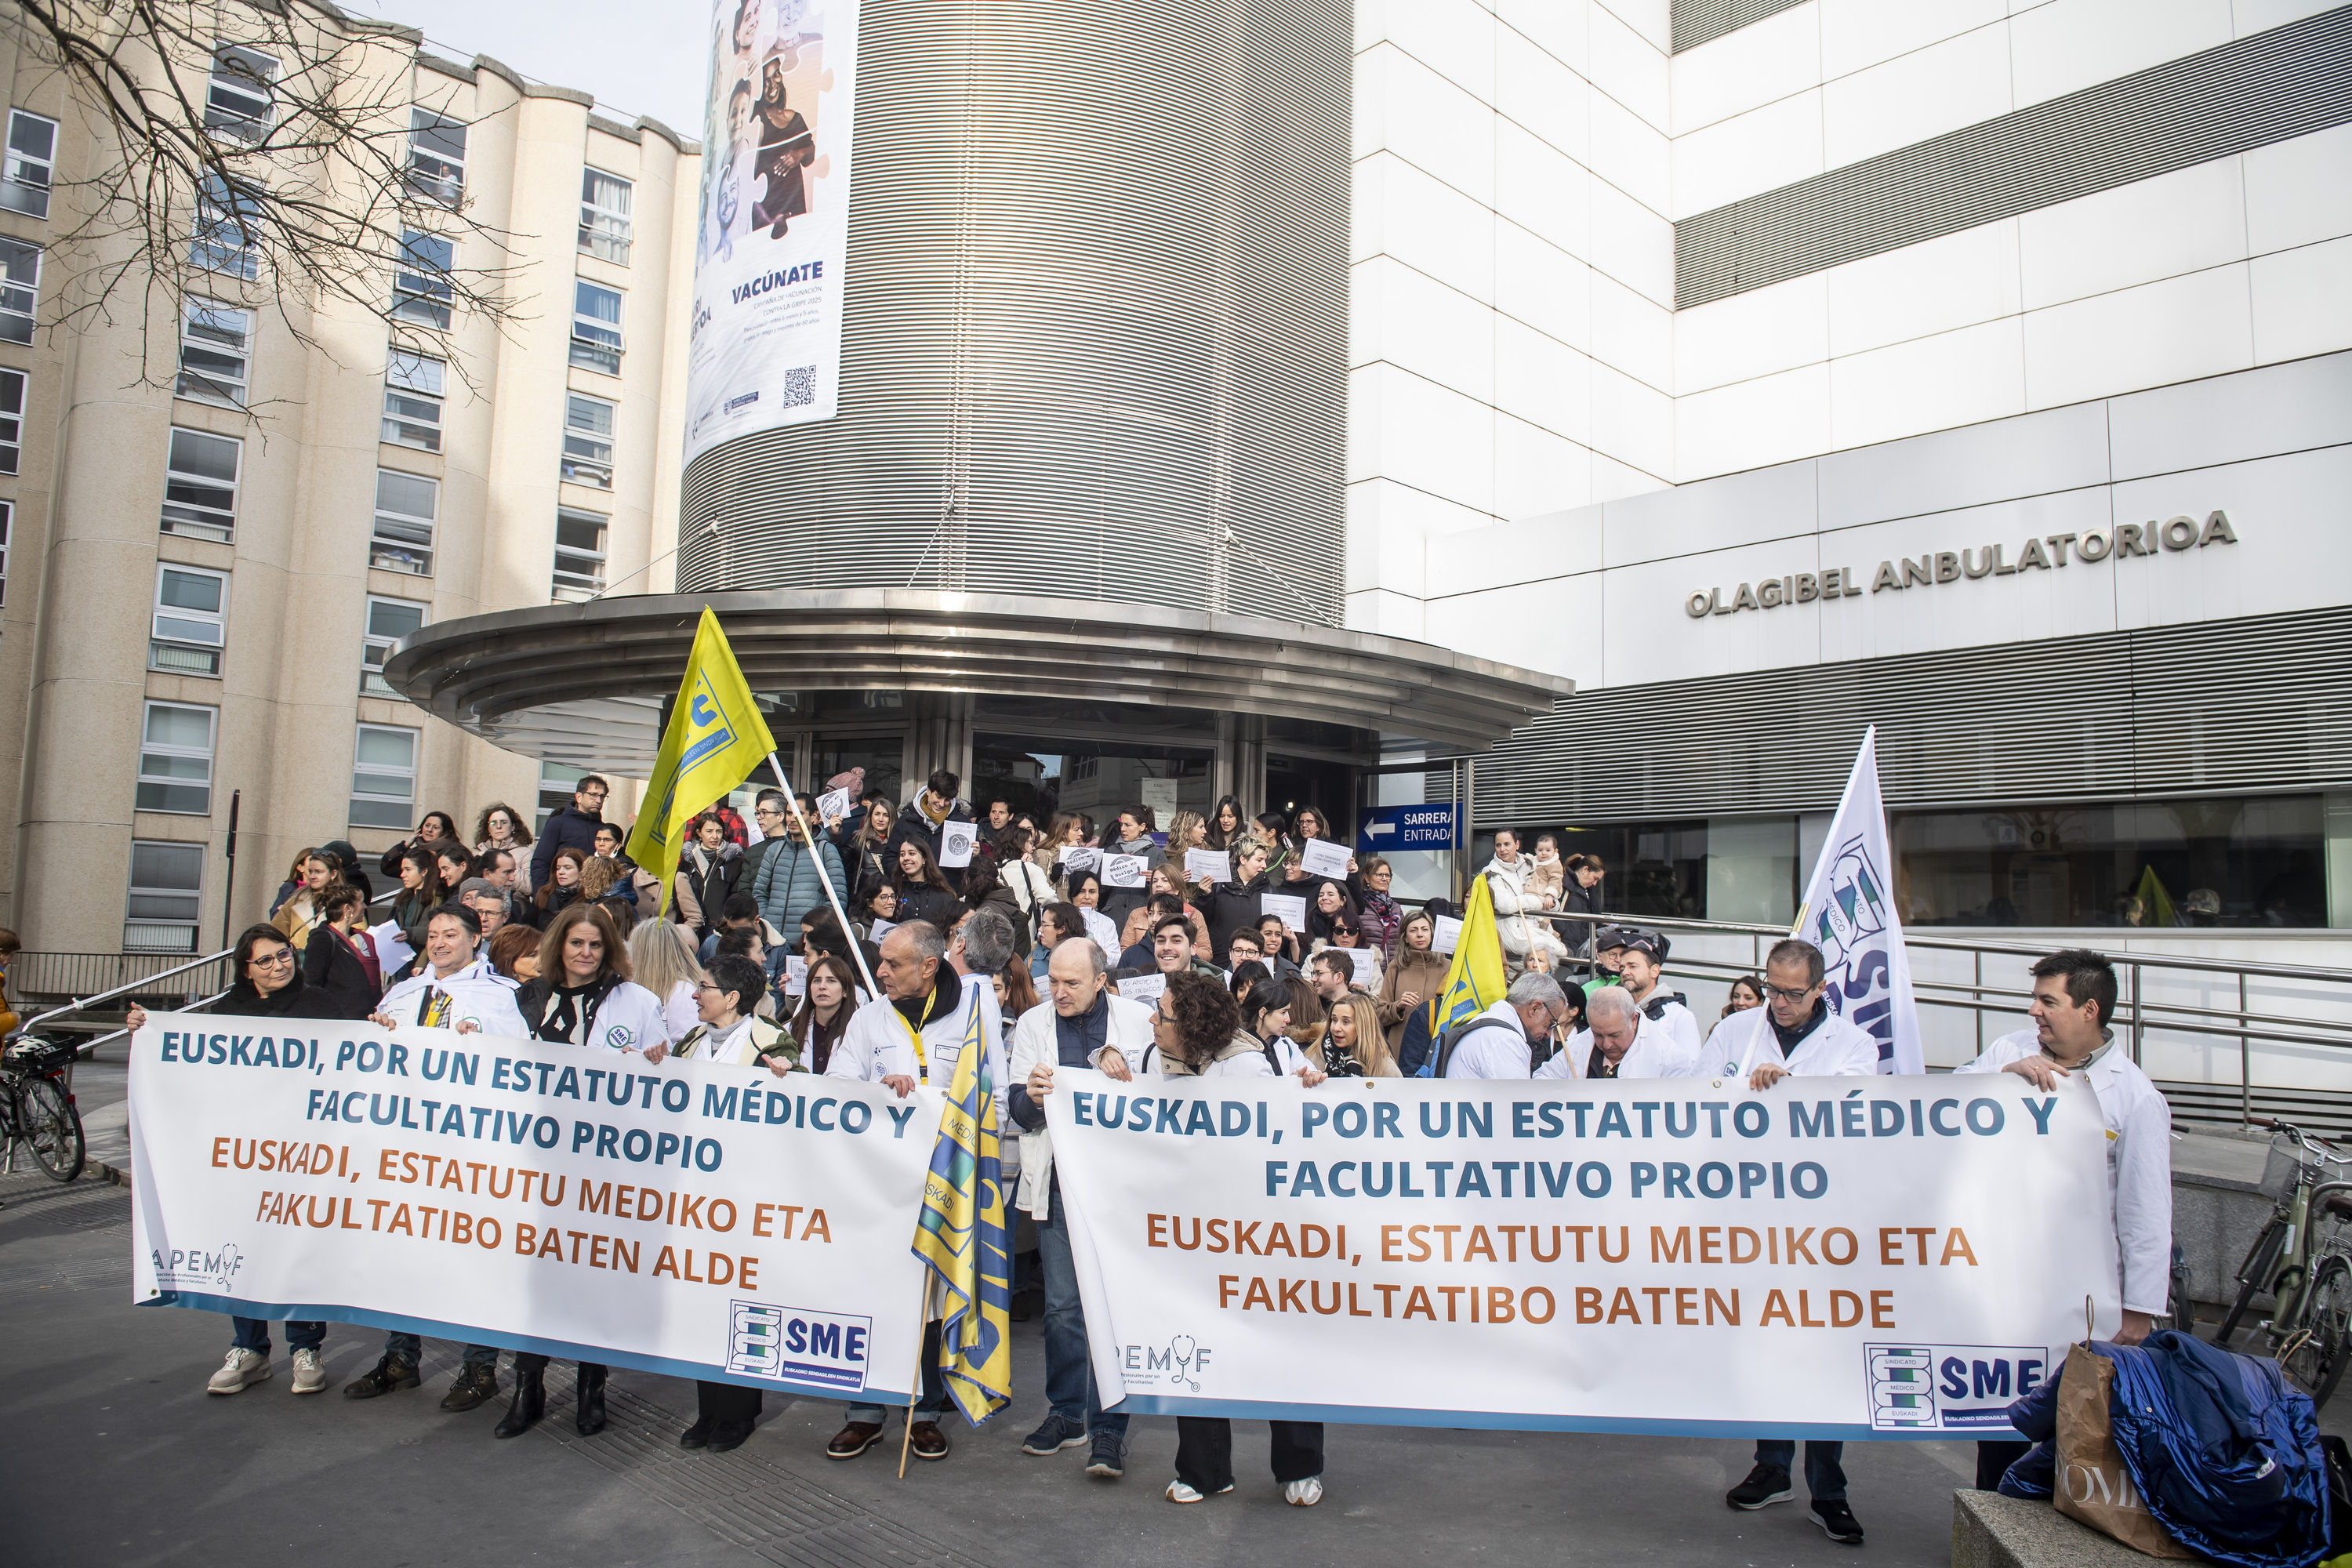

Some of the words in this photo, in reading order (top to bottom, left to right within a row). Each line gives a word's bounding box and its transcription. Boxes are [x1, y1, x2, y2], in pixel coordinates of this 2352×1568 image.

[732, 260, 823, 304] VACÚNATE
[785, 285, 822, 299] VACUNACIÓN
[792, 299, 807, 308] GRIPE
[808, 296, 822, 305] 2025
[1685, 567, 1862, 618] OLAGIBEL
[1871, 510, 2238, 592] ANBULATORIOA
[1066, 856, 1084, 865] Médico
[1135, 985, 1162, 994] MÉDICOS
[614, 1029, 627, 1043] SME
[162, 1033, 324, 1076] EUSKADI,
[336, 1041, 408, 1077] POR
[422, 1048, 479, 1086] UN
[492, 1058, 690, 1113] ESTATUTO
[702, 1080, 872, 1134] MÉDICO
[887, 1105, 916, 1139] Y
[307, 1089, 560, 1149] FACULTATIVO
[572, 1121, 723, 1172] PROPIO
[948, 1117, 976, 1148] MEDIC
[1073, 1091, 1283, 1145] EUSKADI,
[1302, 1102, 1405, 1138] POR
[1419, 1102, 1493, 1138] UN
[1512, 1102, 1769, 1138] ESTATUTO
[1789, 1089, 2005, 1138] MÉDICO
[2022, 1097, 2059, 1135] Y
[212, 1137, 361, 1183] EUSKADI,
[378, 1149, 567, 1207] ESTATUTU
[579, 1179, 738, 1232] MEDIKO
[753, 1202, 832, 1243] ETA
[925, 1181, 955, 1212] SKADI
[1265, 1161, 1612, 1199] FACULTATIVO
[1630, 1161, 1828, 1200] PROPIO
[256, 1190, 503, 1250] FAKULTATIBO
[515, 1222, 641, 1274] BATEN
[652, 1245, 760, 1290] ALDE
[1147, 1213, 1362, 1266] EUSKADI,
[1381, 1225, 1629, 1263] ESTATUTU
[1650, 1225, 1858, 1265] MEDIKO
[1878, 1227, 1979, 1266] ETA
[745, 1314, 771, 1323] SINDICATO
[1218, 1275, 1555, 1324] FAKULTATIBO
[1574, 1287, 1740, 1326] BATEN
[1759, 1289, 1896, 1328] ALDE
[785, 1318, 867, 1362] SME
[1116, 1339, 1211, 1373] EMYF
[784, 1367, 808, 1375] EUSKADIKO
[808, 1370, 837, 1379] SENDAGILEEN
[836, 1374, 861, 1383] SINDIKATUA
[1940, 1356, 2043, 1399] SME
